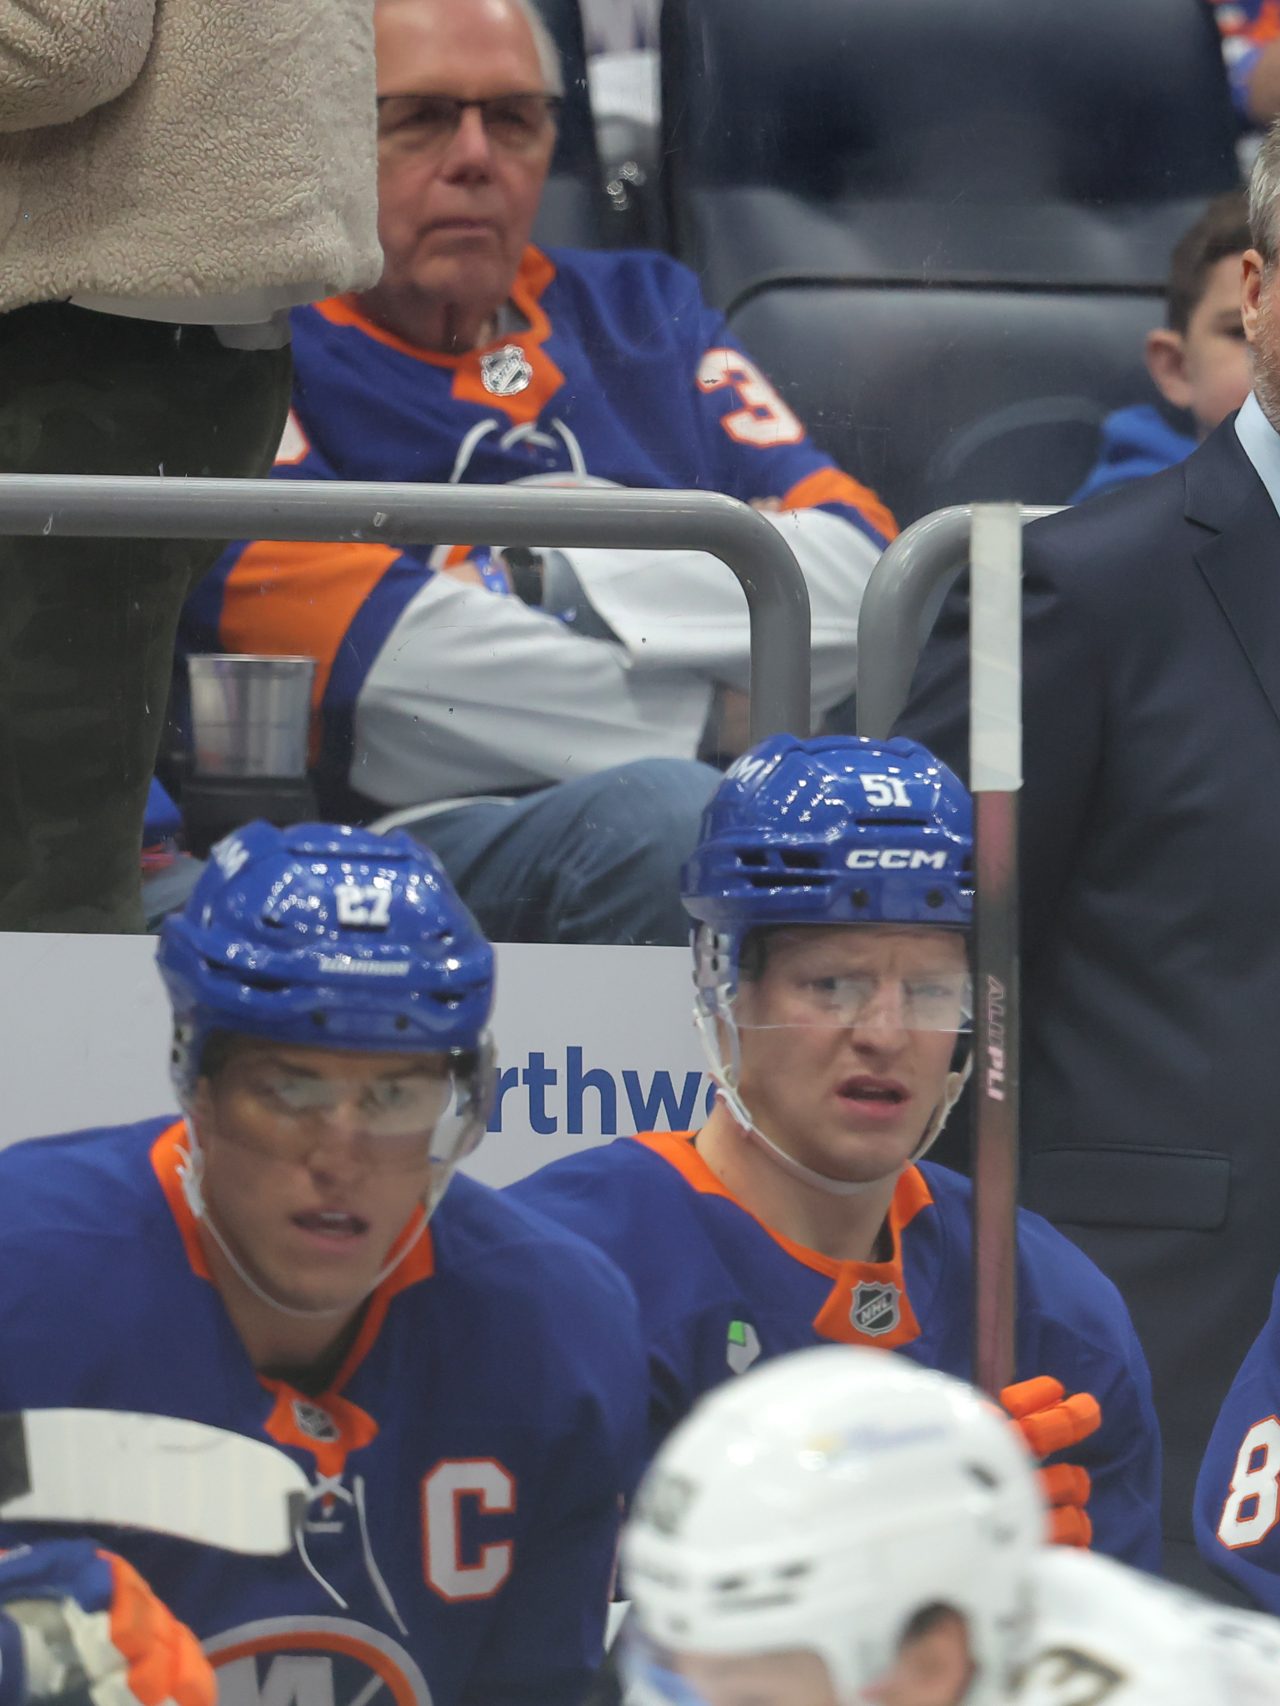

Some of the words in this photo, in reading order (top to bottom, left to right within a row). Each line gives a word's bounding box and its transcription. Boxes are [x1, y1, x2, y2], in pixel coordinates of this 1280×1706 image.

[859, 774, 912, 807] 51
[846, 849, 947, 869] CCM
[333, 883, 392, 922] 27
[861, 1296, 888, 1323] NHL
[421, 1457, 517, 1602] C
